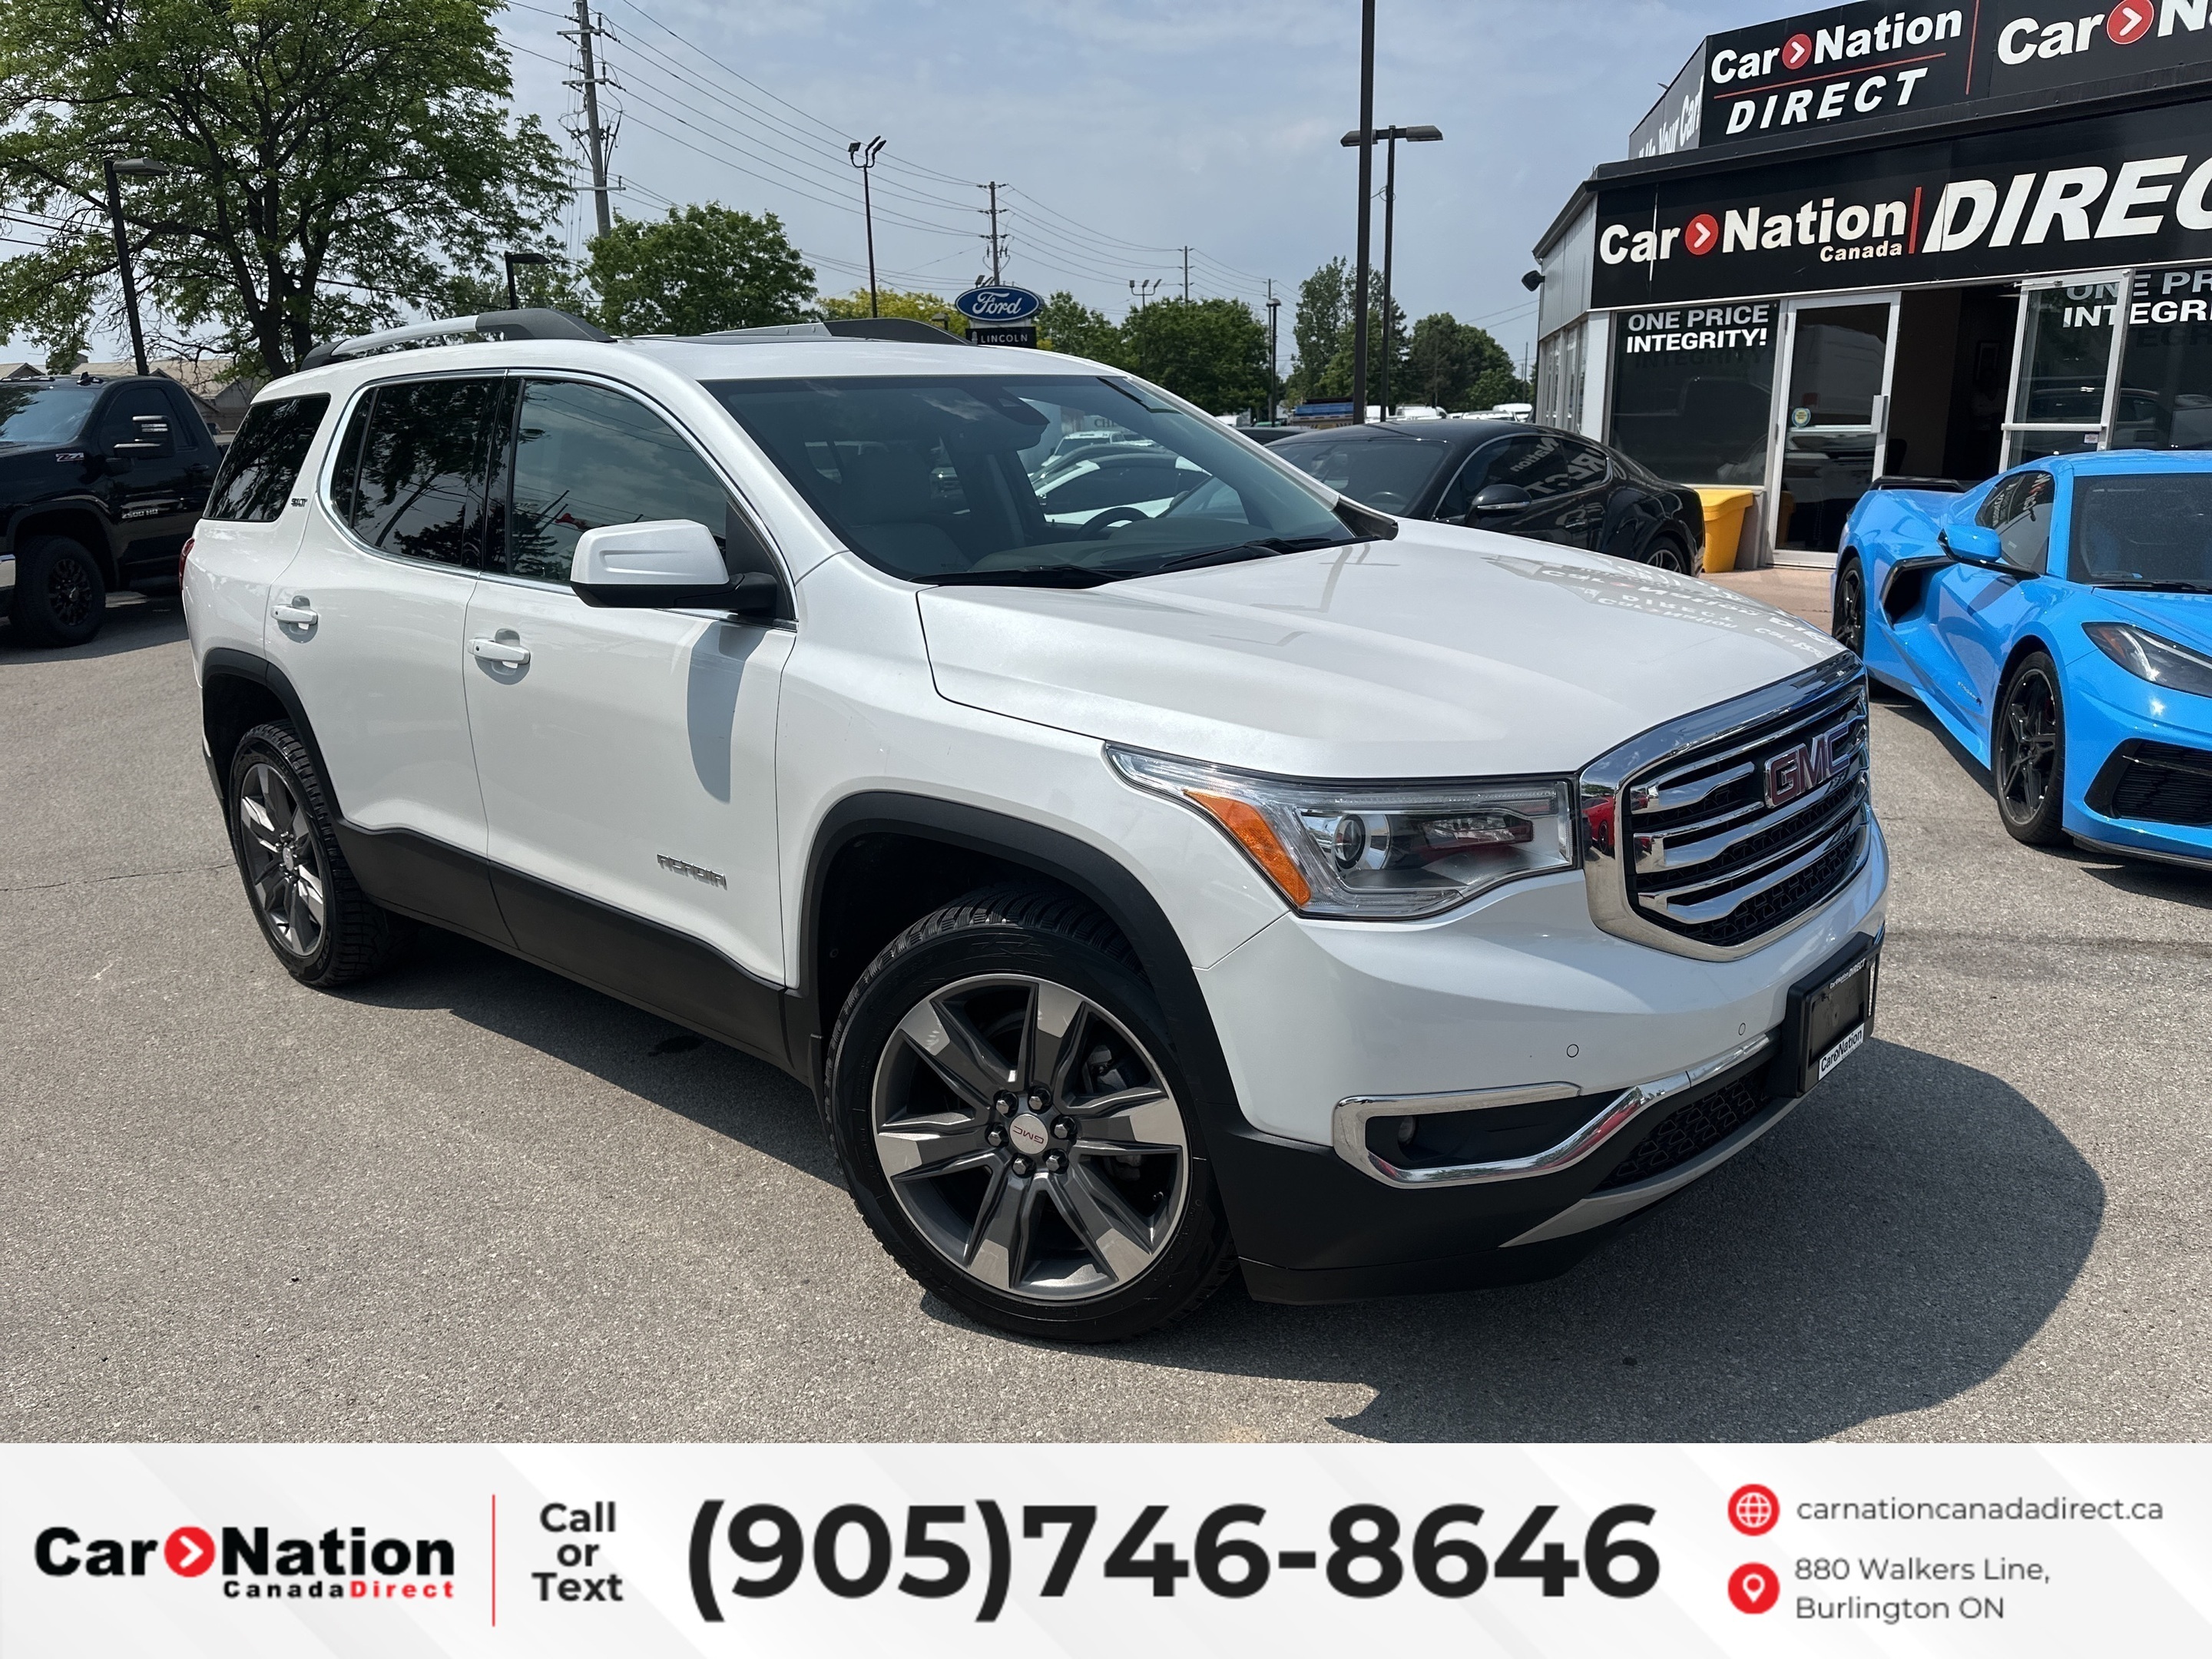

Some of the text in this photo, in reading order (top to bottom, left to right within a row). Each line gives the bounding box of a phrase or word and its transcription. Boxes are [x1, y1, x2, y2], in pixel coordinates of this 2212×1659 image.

[1711, 10, 1962, 84] Car Nation
[1998, 14, 2105, 65] Car
[1726, 67, 1929, 134] DIRECT
[1600, 224, 1681, 265] Car
[1722, 197, 1906, 253] Nation
[1820, 240, 1902, 262] Canada
[972, 291, 1022, 314] Ford
[1628, 304, 1770, 332] ONE PRICE
[980, 334, 1028, 343] LINCOLN
[1626, 328, 1767, 353] INTEGRITY!
[1764, 721, 1849, 809] GMC
[1838, 1030, 1863, 1058] Nation
[1012, 1125, 1045, 1144] GMC
